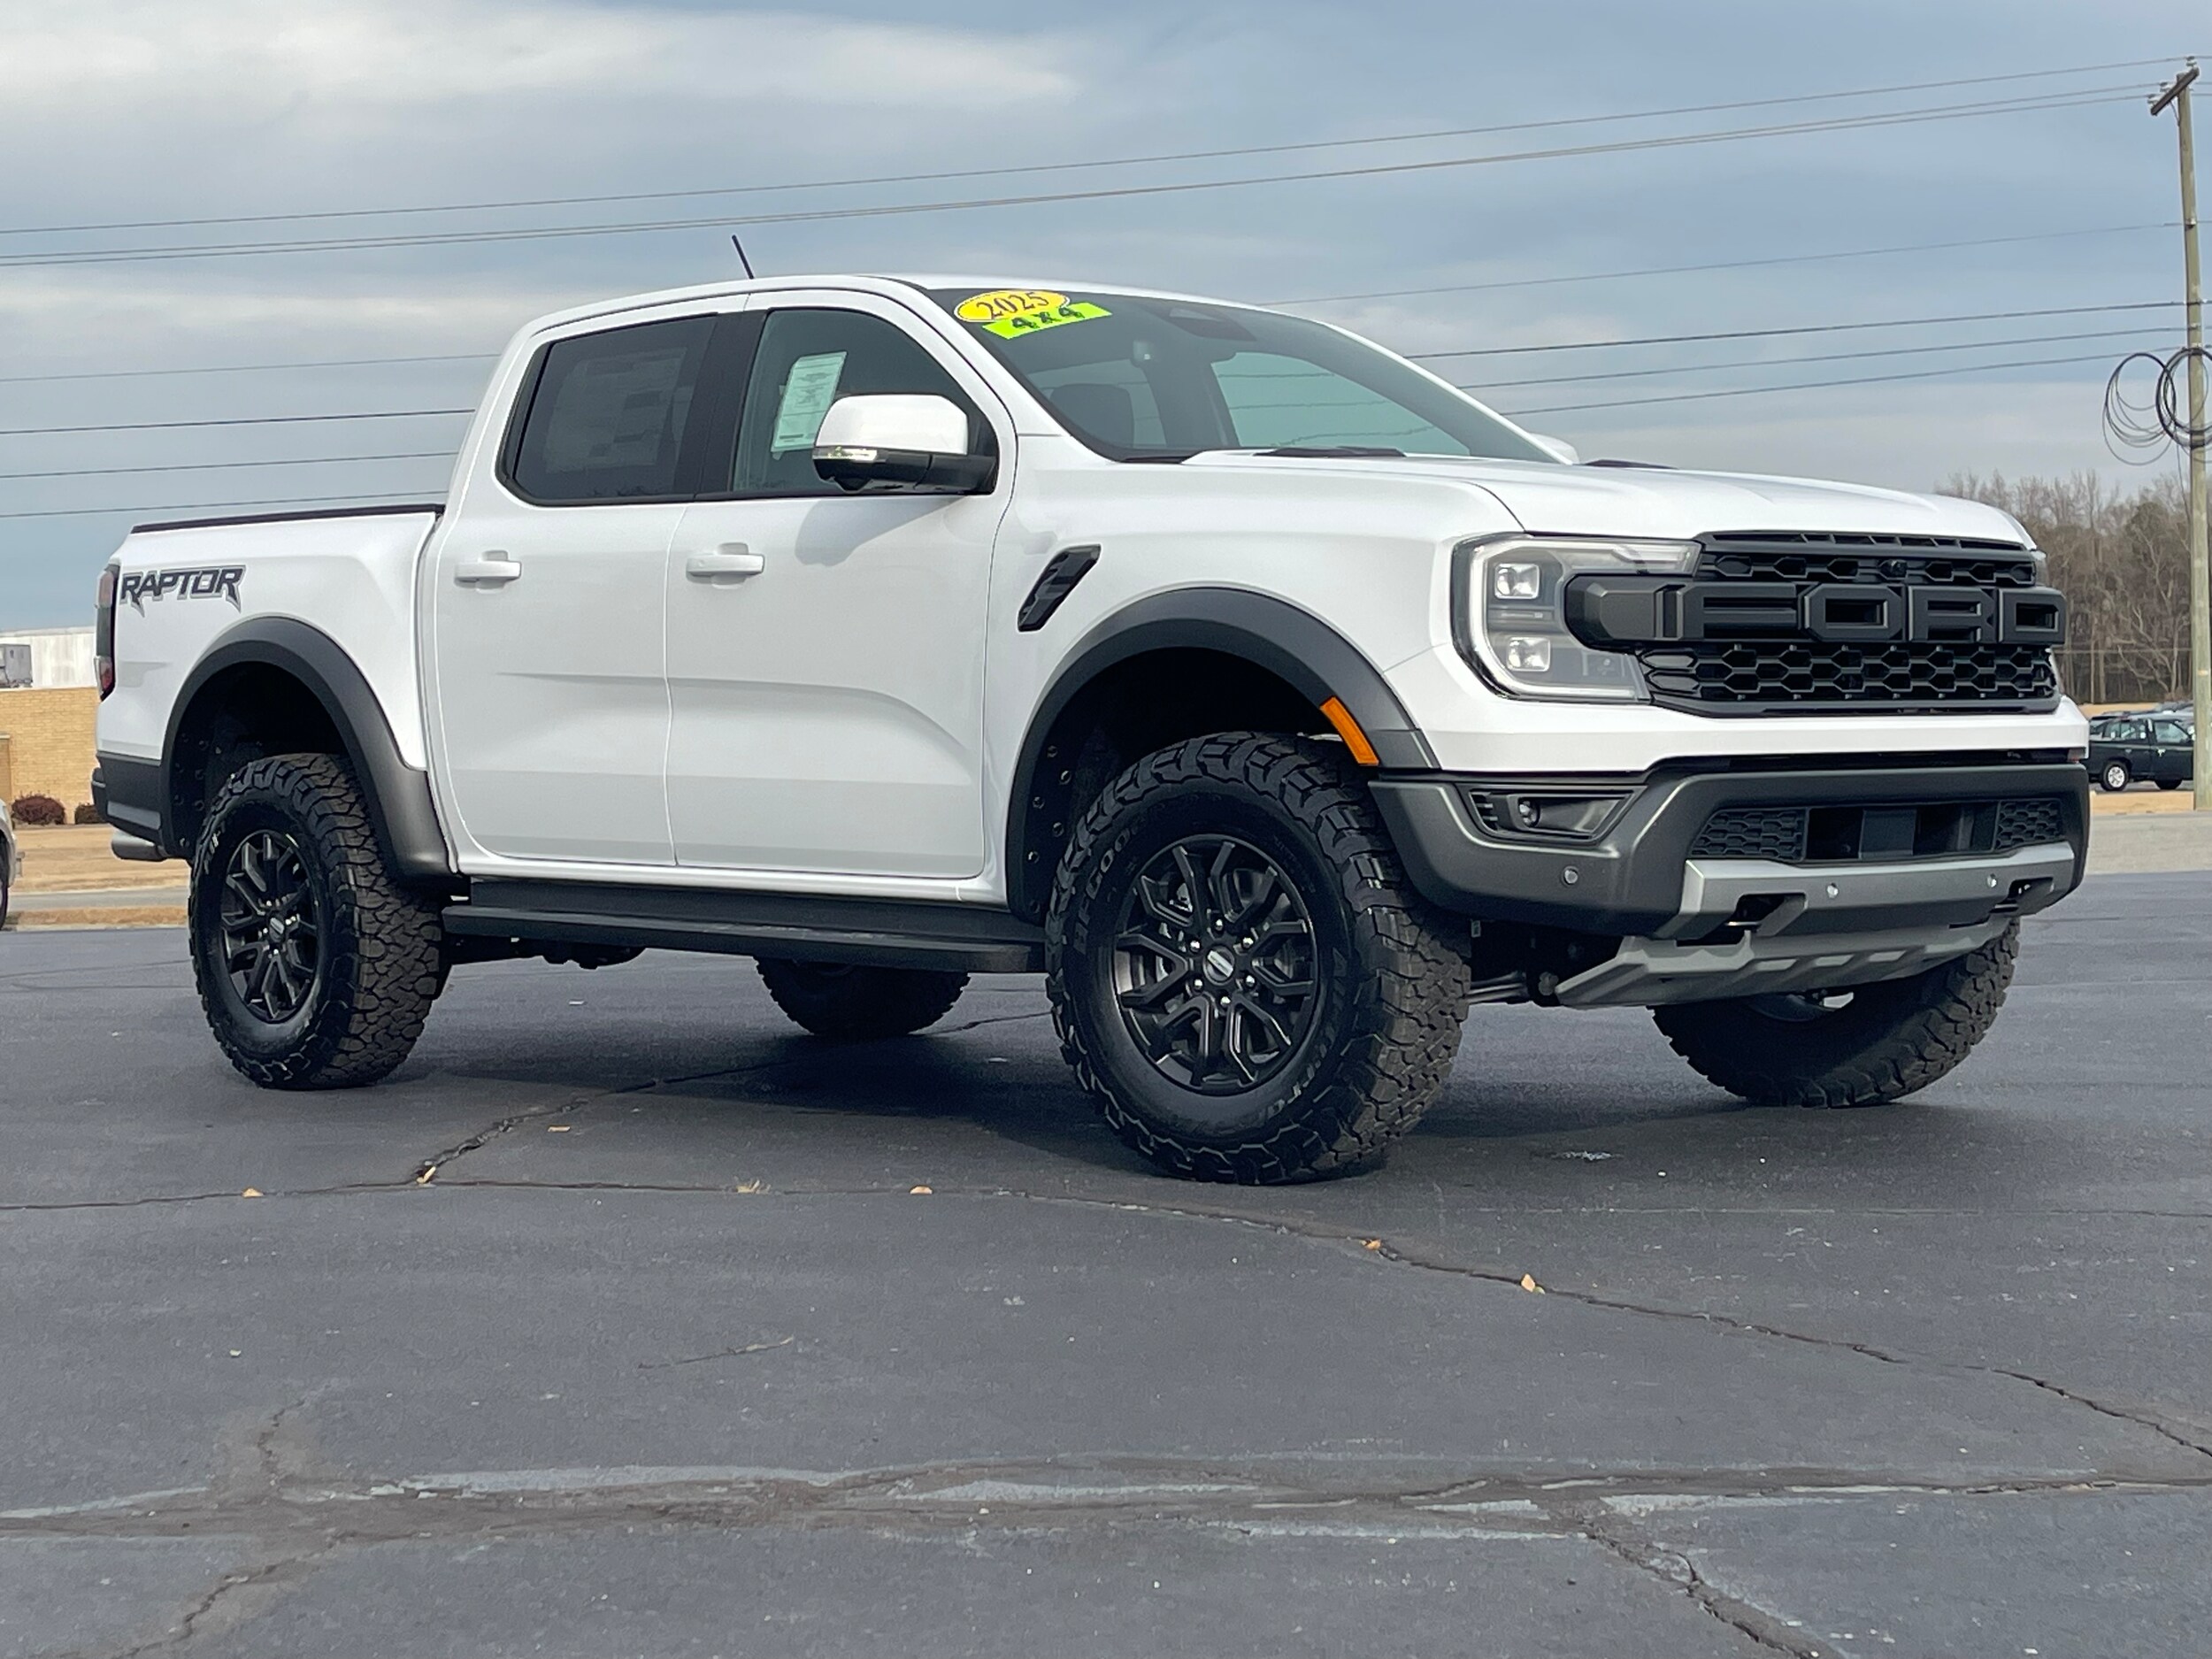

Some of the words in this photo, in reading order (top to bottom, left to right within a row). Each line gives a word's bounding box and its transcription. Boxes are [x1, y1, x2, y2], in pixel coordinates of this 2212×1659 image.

[977, 292, 1050, 319] 2025
[119, 565, 246, 618] RAPTOR
[1674, 580, 2067, 645] FORD
